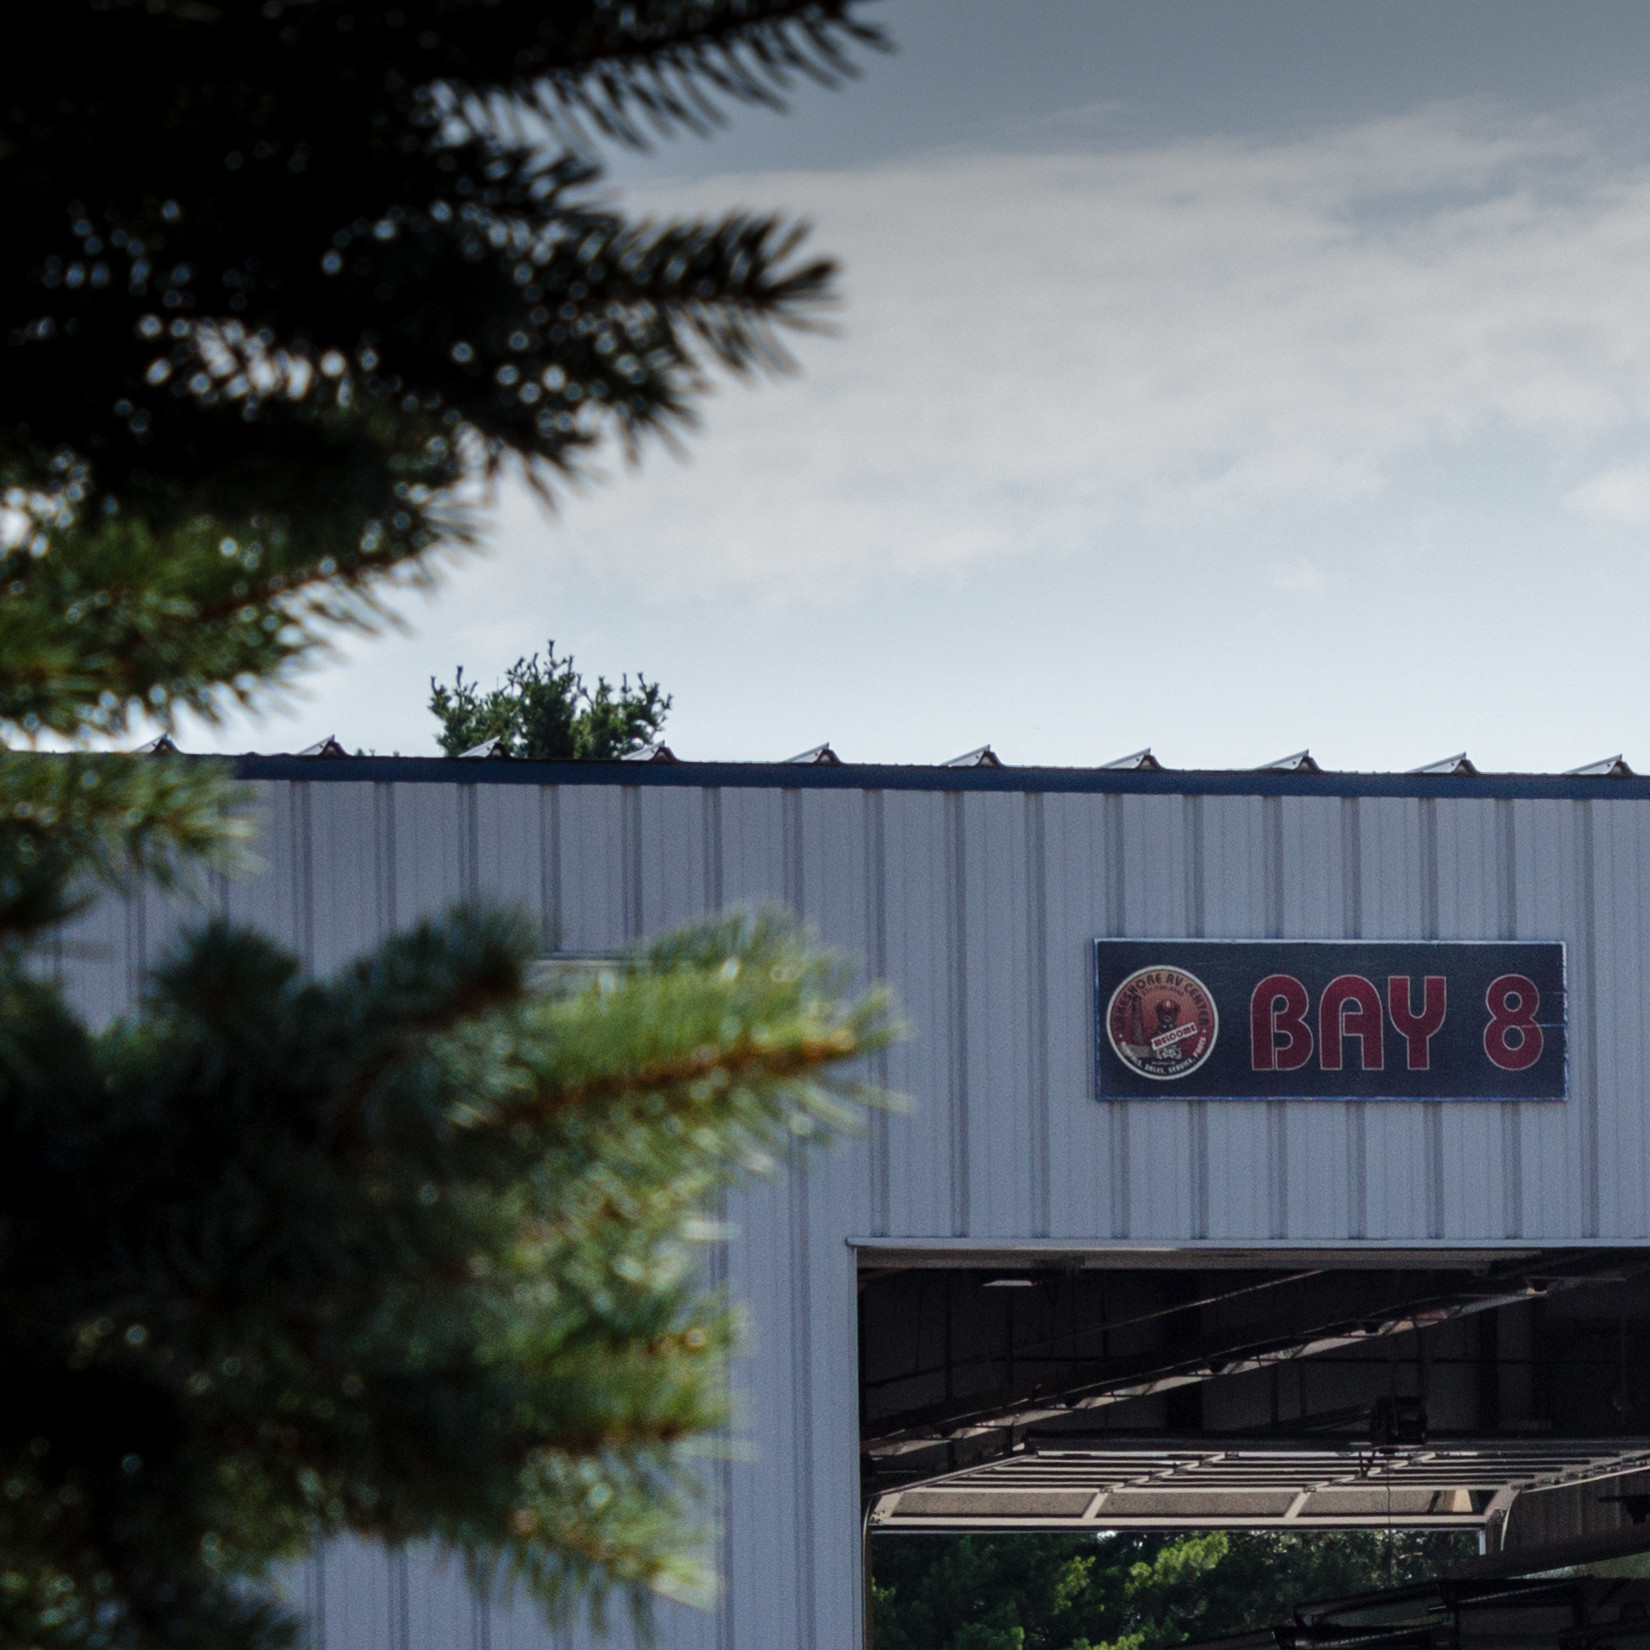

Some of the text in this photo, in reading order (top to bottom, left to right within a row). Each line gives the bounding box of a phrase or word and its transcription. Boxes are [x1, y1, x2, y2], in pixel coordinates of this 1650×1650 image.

[1114, 974, 1210, 1031] LAKESHORE RV CENTER
[1250, 973, 1544, 1071] BAY 8
[1153, 1025, 1196, 1047] WELCOME
